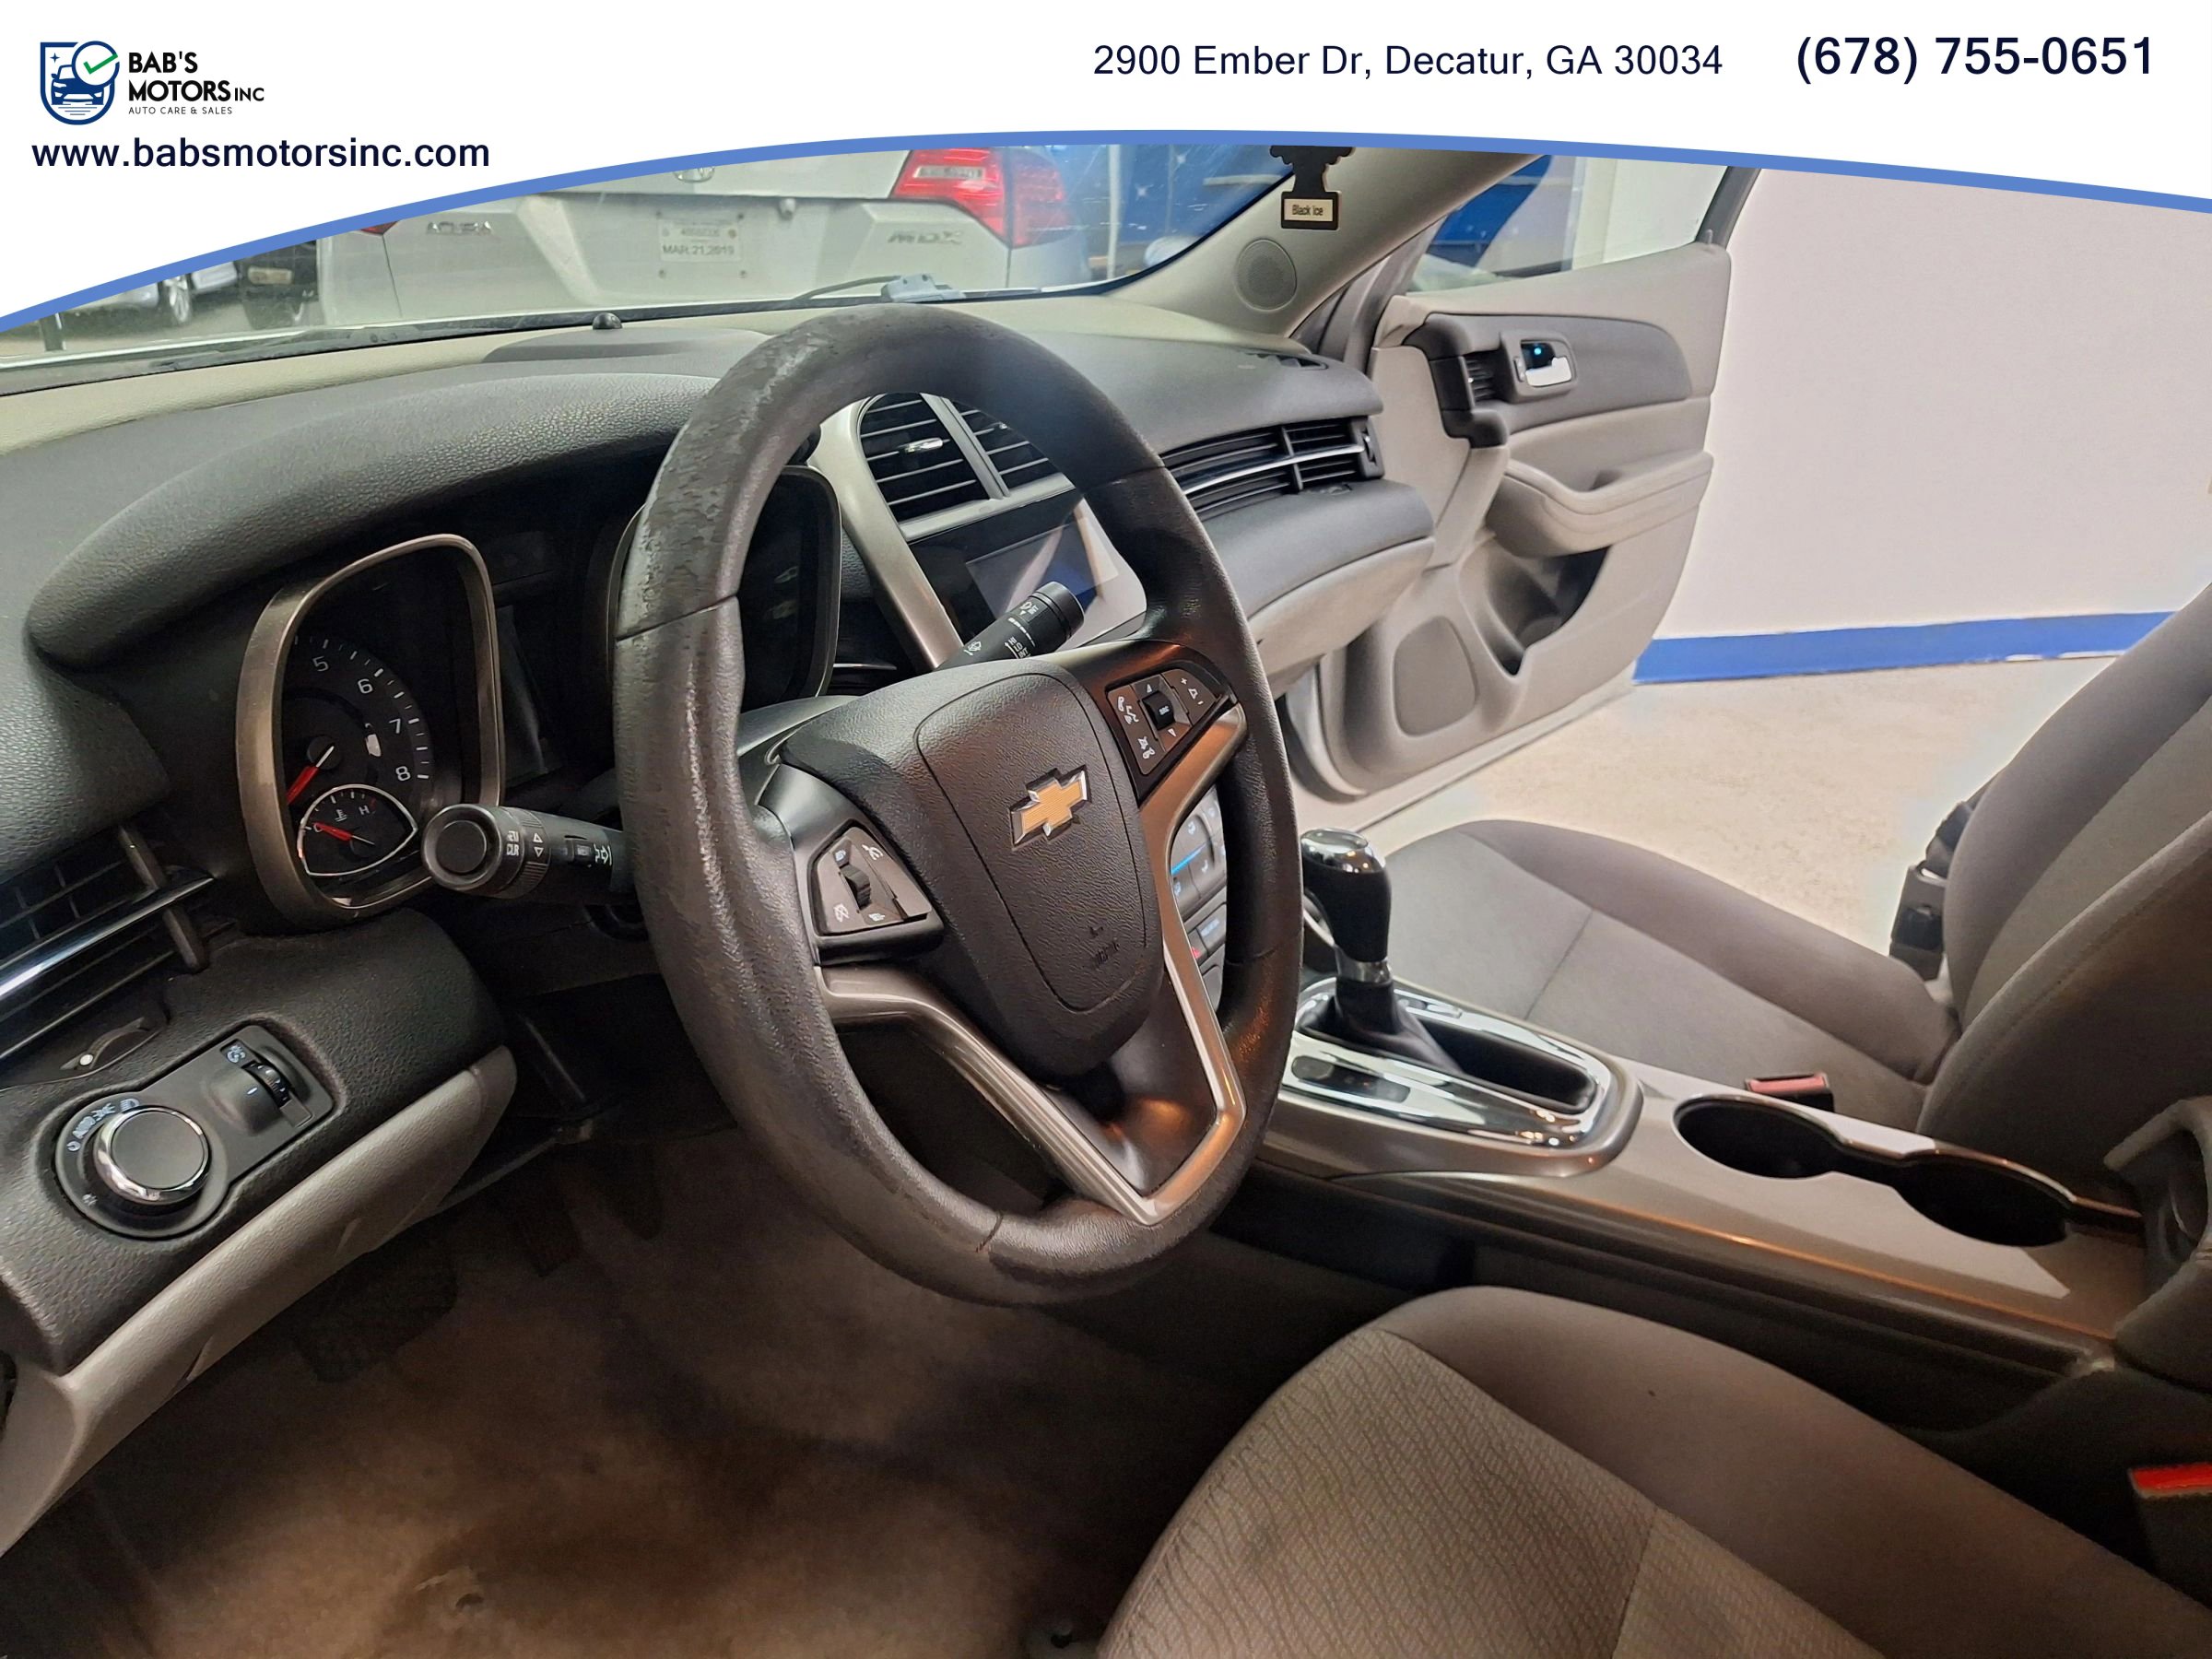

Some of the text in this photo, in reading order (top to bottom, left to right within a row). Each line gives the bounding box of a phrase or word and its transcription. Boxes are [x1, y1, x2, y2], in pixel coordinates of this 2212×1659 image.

[1292, 205, 1311, 216] Black
[312, 656, 329, 672] 5
[358, 678, 373, 694] 6
[389, 718, 401, 734] 7
[395, 766, 411, 782] 8
[359, 805, 370, 816] H
